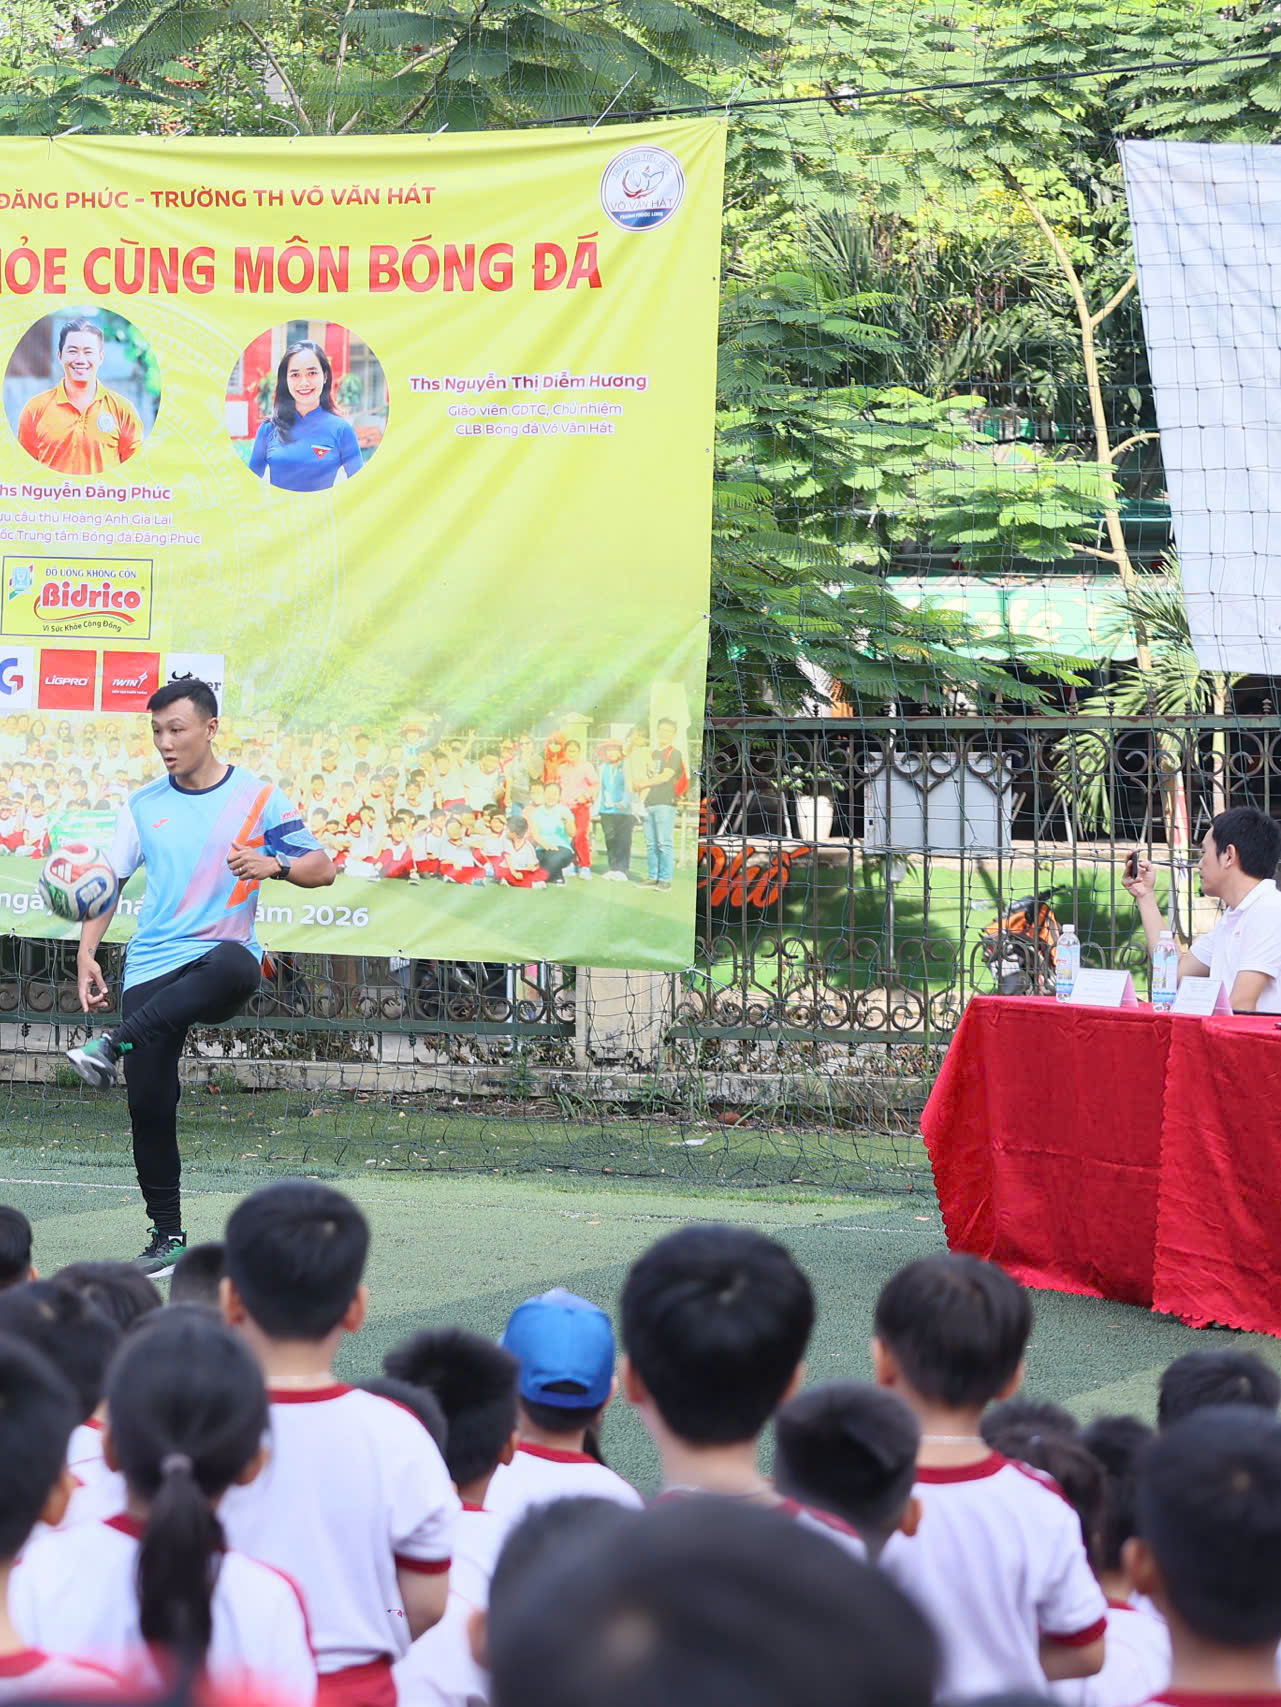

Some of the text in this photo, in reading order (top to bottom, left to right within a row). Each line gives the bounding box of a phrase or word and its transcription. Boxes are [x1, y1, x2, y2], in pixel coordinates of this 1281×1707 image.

[65, 186, 129, 209] PHÚC
[150, 186, 247, 208] TRƯỜNG
[253, 189, 284, 207] TH
[291, 184, 323, 206] VÕ
[331, 184, 381, 206] VĂN
[387, 183, 437, 205] HÁT
[84, 237, 216, 295] CÙNG
[234, 235, 350, 294] MÔN
[369, 233, 514, 293] BÓNG
[532, 231, 603, 291] ĐÁ
[410, 371, 647, 393] Ths Nguyễn Thị Diễm Hương
[480, 404, 508, 416] viên
[580, 402, 622, 417] nhiệm
[455, 423, 482, 435] CLB
[486, 421, 519, 437] Bóng
[522, 422, 539, 434] đá
[21, 482, 81, 501] Nguyễn
[85, 485, 127, 502] Đăng
[131, 486, 171, 499] Phúc
[62, 512, 102, 527] Hoàng
[105, 513, 129, 525] Anh
[132, 514, 151, 525] Gia
[154, 514, 172, 526] Lai
[17, 529, 52, 544] Trung
[82, 530, 114, 545] Bóng
[42, 581, 141, 609] Bidrico
[299, 904, 369, 928] 2026
